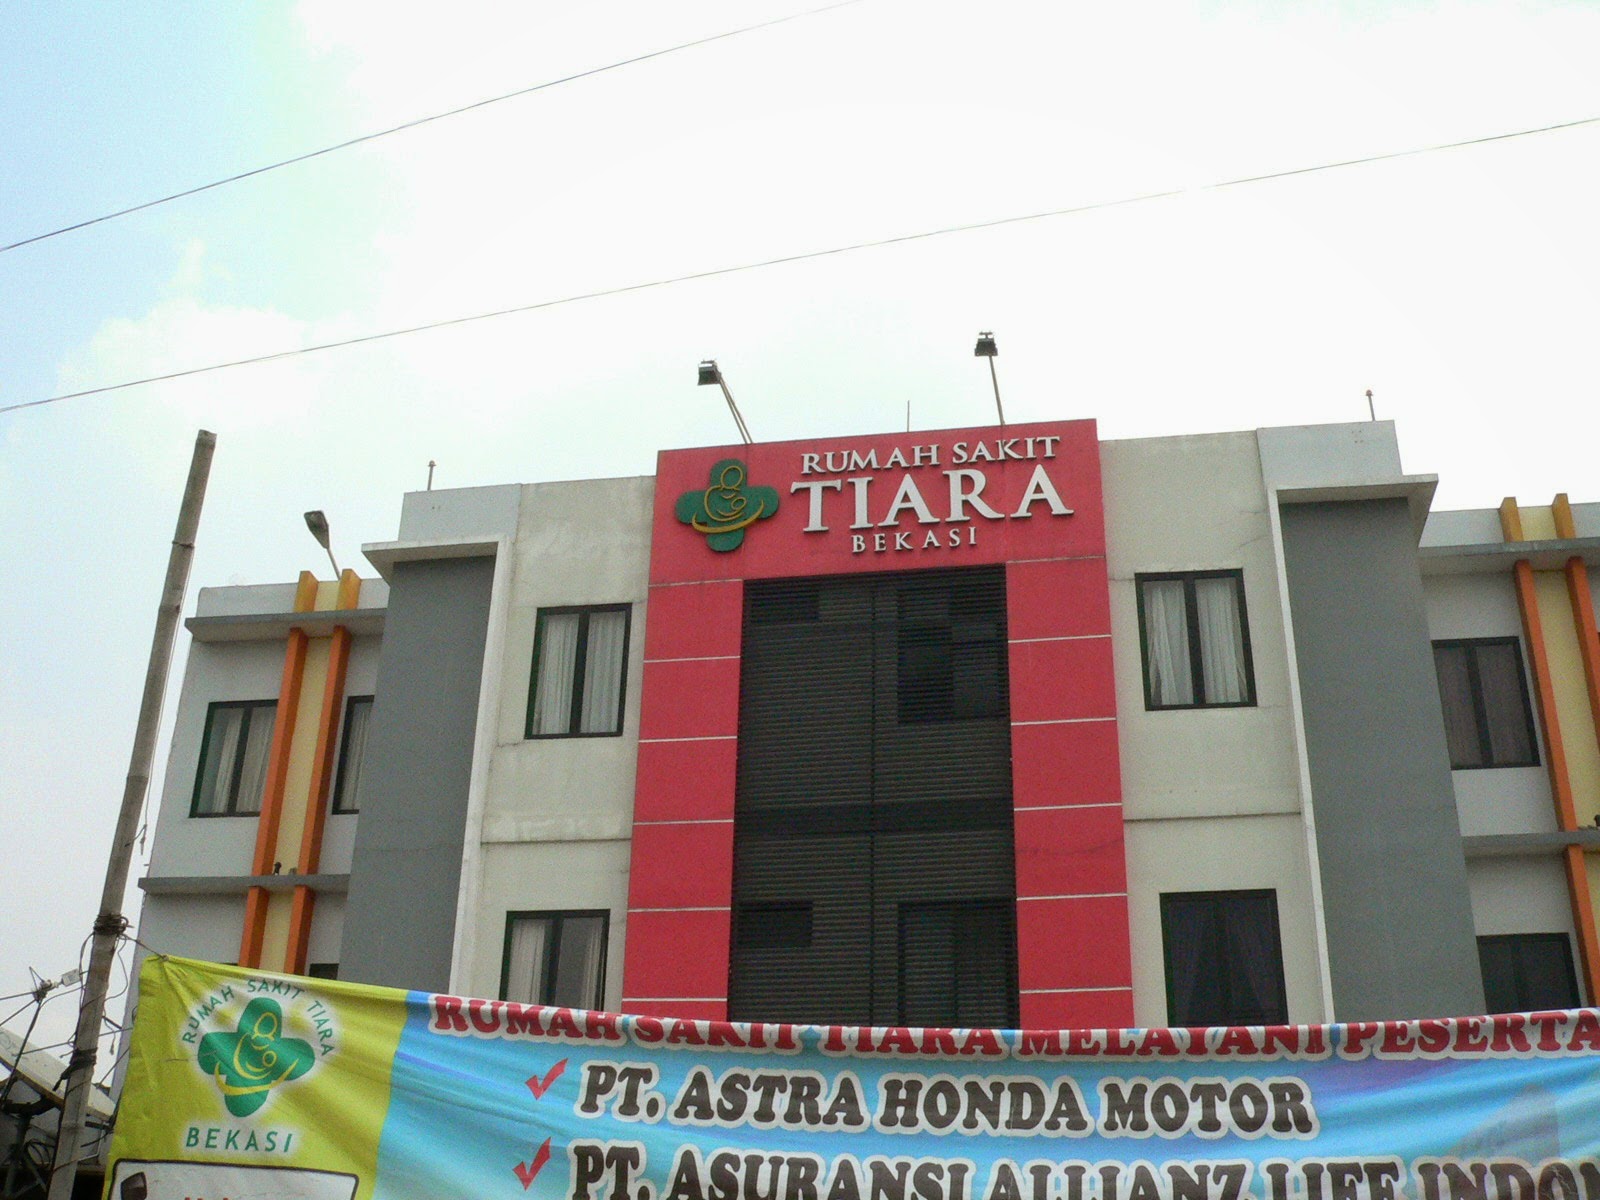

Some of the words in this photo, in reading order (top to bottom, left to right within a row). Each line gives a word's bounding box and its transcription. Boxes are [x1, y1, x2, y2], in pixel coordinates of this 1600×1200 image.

[801, 443, 939, 474] RUMAH
[952, 436, 1060, 464] SAKIT
[790, 464, 1075, 532] TIARA
[851, 526, 977, 553] BEKASI
[182, 985, 235, 1044] RUMAH
[247, 979, 305, 999] SAKIT
[307, 1000, 335, 1056] TIARA
[434, 995, 621, 1041] RUMAH
[634, 1016, 799, 1050] SAKIT
[823, 1025, 1002, 1056] TIARA
[1018, 1024, 1327, 1056] MELAYANI
[1343, 1011, 1600, 1054] PESERTA
[581, 1065, 659, 1118] PT.
[674, 1071, 865, 1126] ASTRA
[879, 1078, 1089, 1131] HONDA
[1103, 1082, 1313, 1133] MOTOR
[186, 1127, 293, 1153] BEKASI
[572, 1145, 650, 1200] PT.
[666, 1150, 969, 1200] ASURANSI
